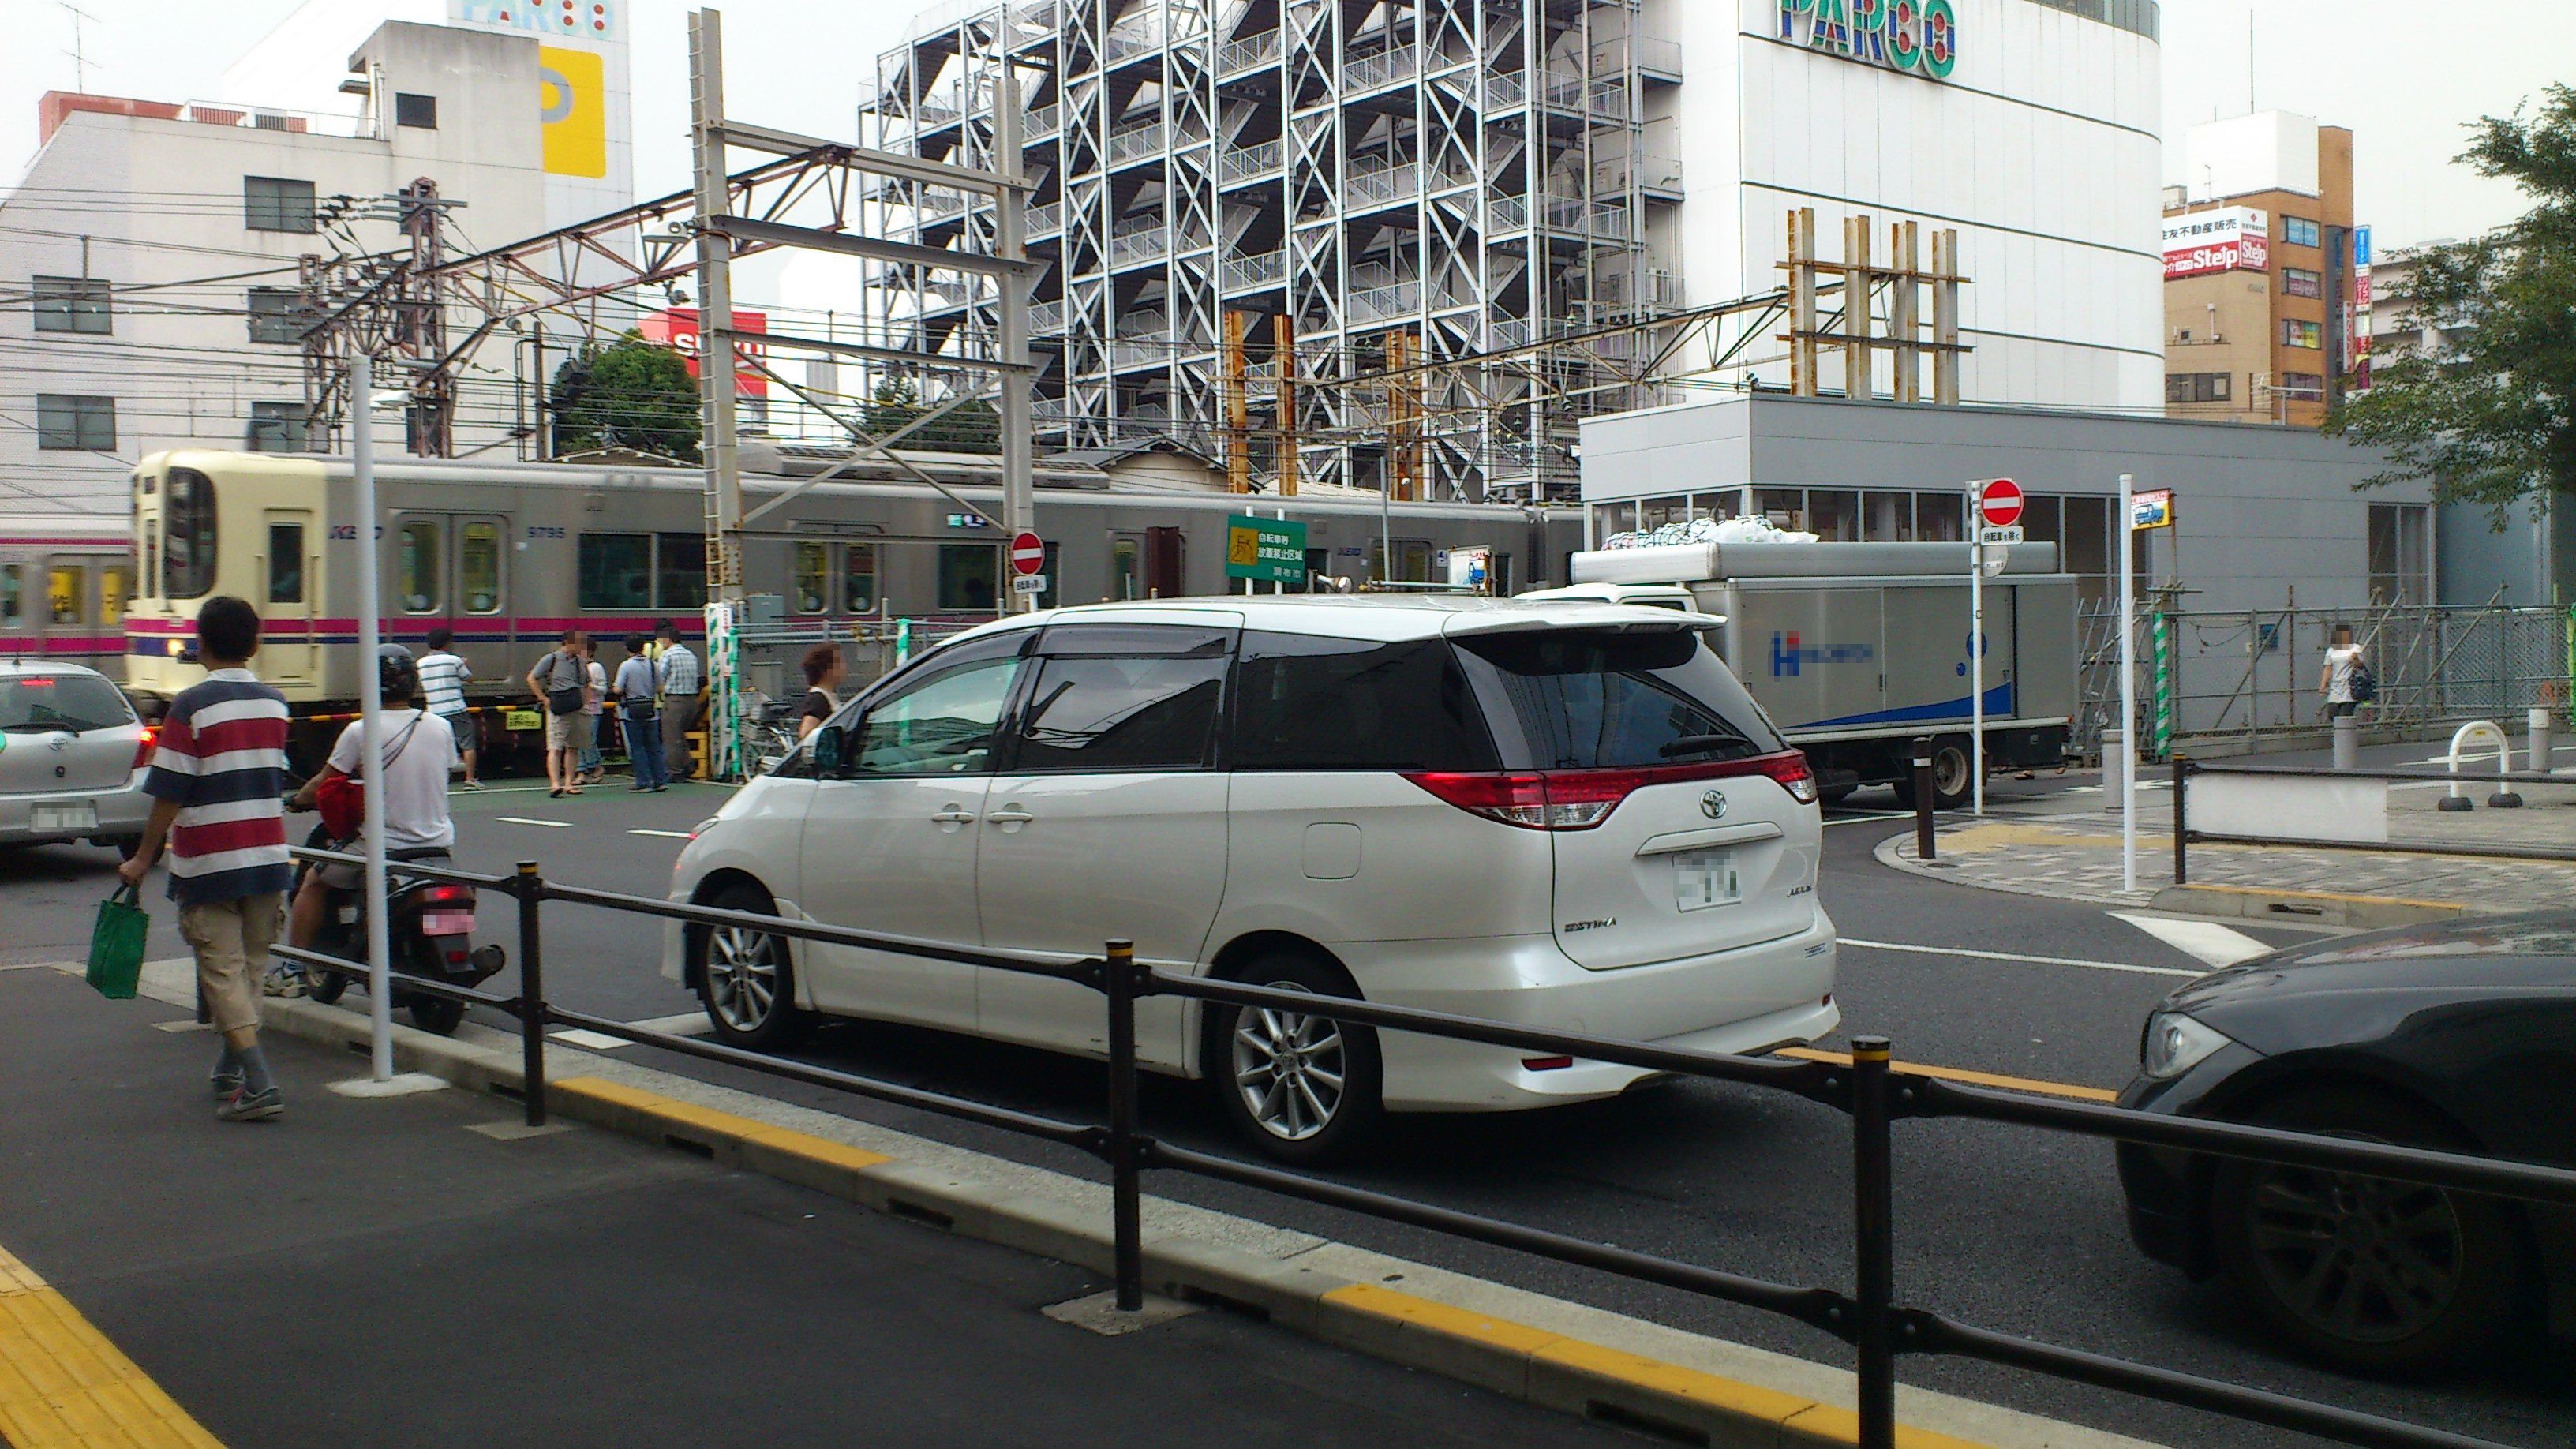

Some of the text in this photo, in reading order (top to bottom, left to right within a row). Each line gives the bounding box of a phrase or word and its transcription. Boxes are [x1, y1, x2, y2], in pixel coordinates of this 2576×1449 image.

[1777, 0, 1956, 77] PARCO
[2193, 246, 2238, 269] Step
[2241, 241, 2267, 267] Step
[1983, 530, 2020, 542] 自転車を除く
